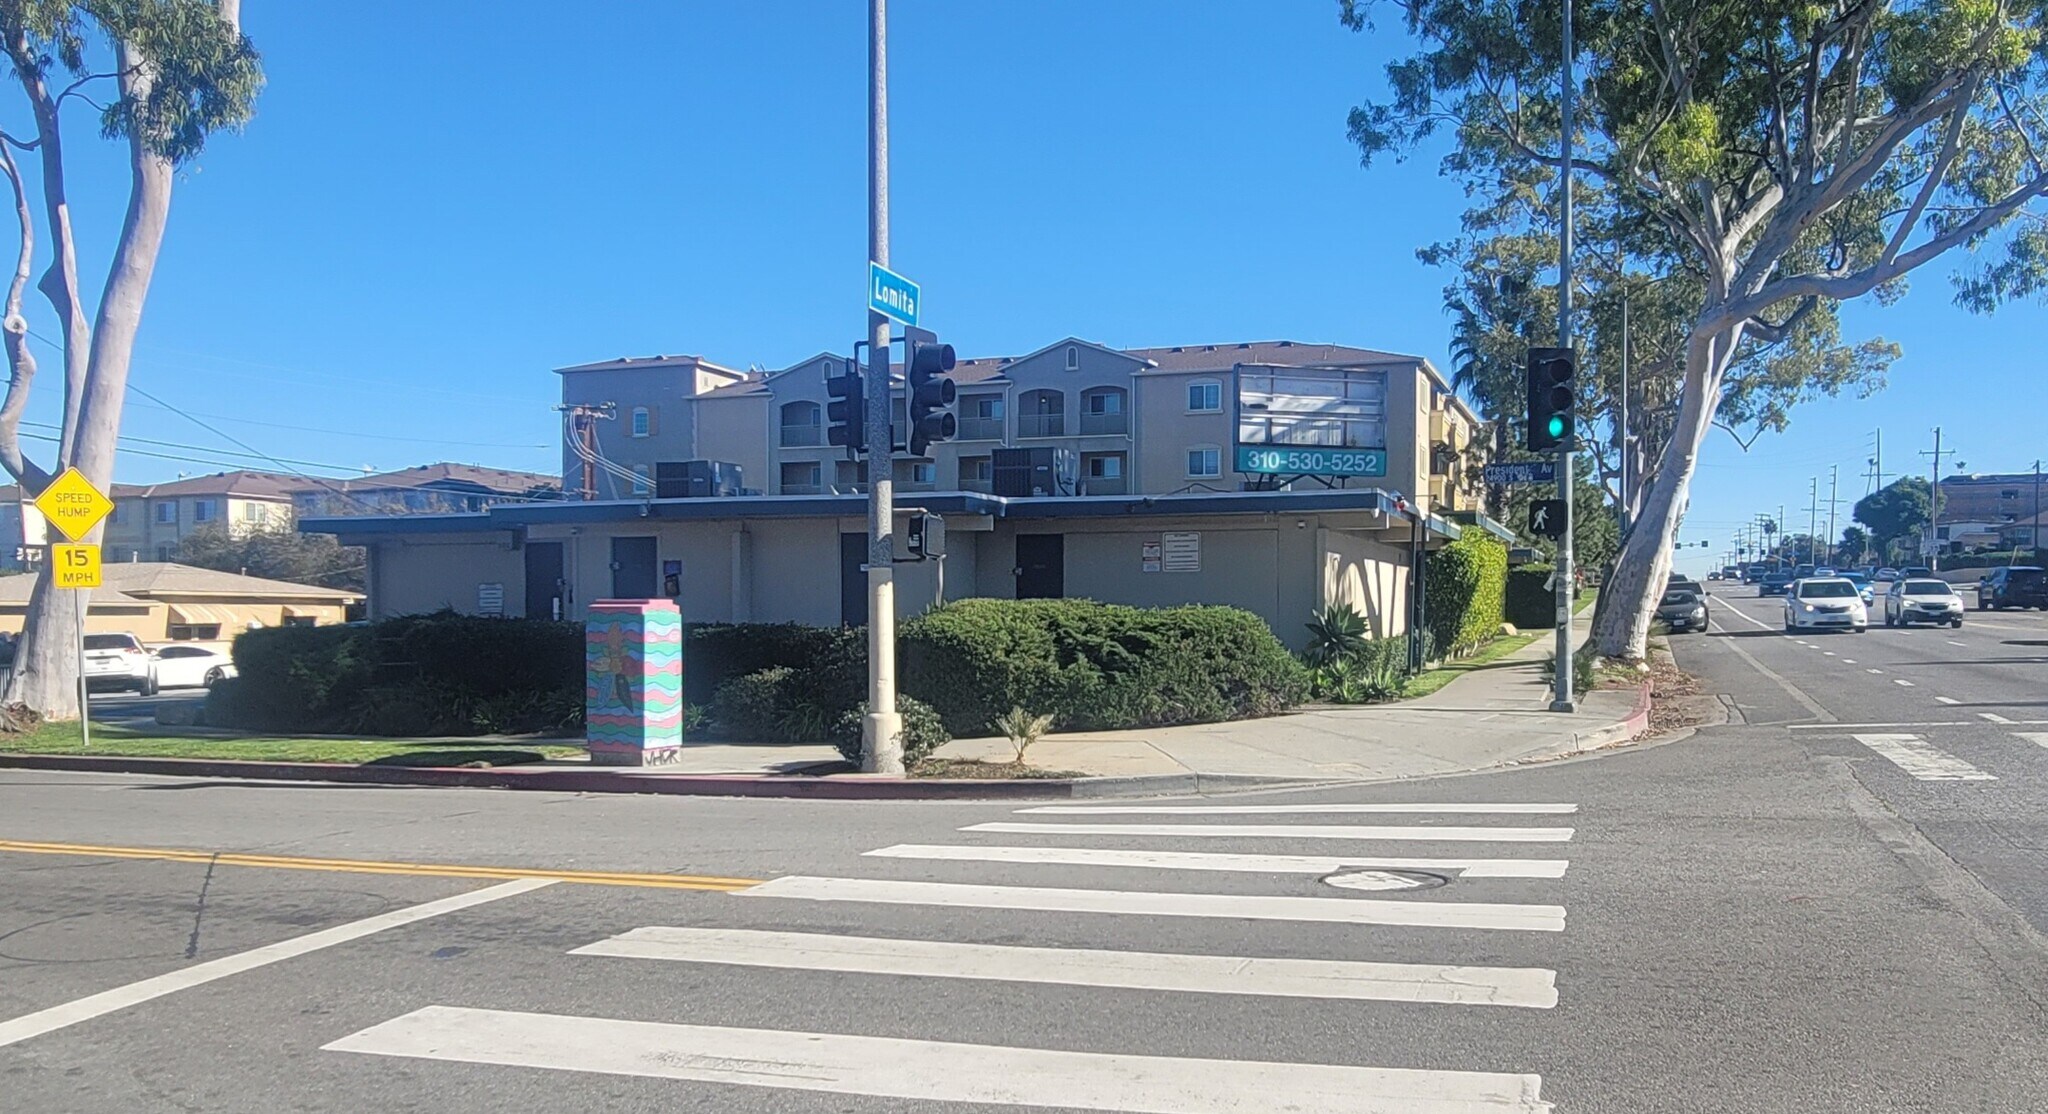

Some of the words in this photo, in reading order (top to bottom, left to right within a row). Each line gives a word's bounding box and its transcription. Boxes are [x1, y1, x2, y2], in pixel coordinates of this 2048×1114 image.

[875, 276, 914, 316] Lomita
[1247, 451, 1377, 472] 310-530-5252
[1485, 464, 1530, 476] President
[1540, 463, 1552, 474] Av
[55, 493, 92, 503] SPEED
[57, 507, 91, 517] HUMP
[65, 549, 88, 566] 15
[63, 572, 93, 583] MPH
